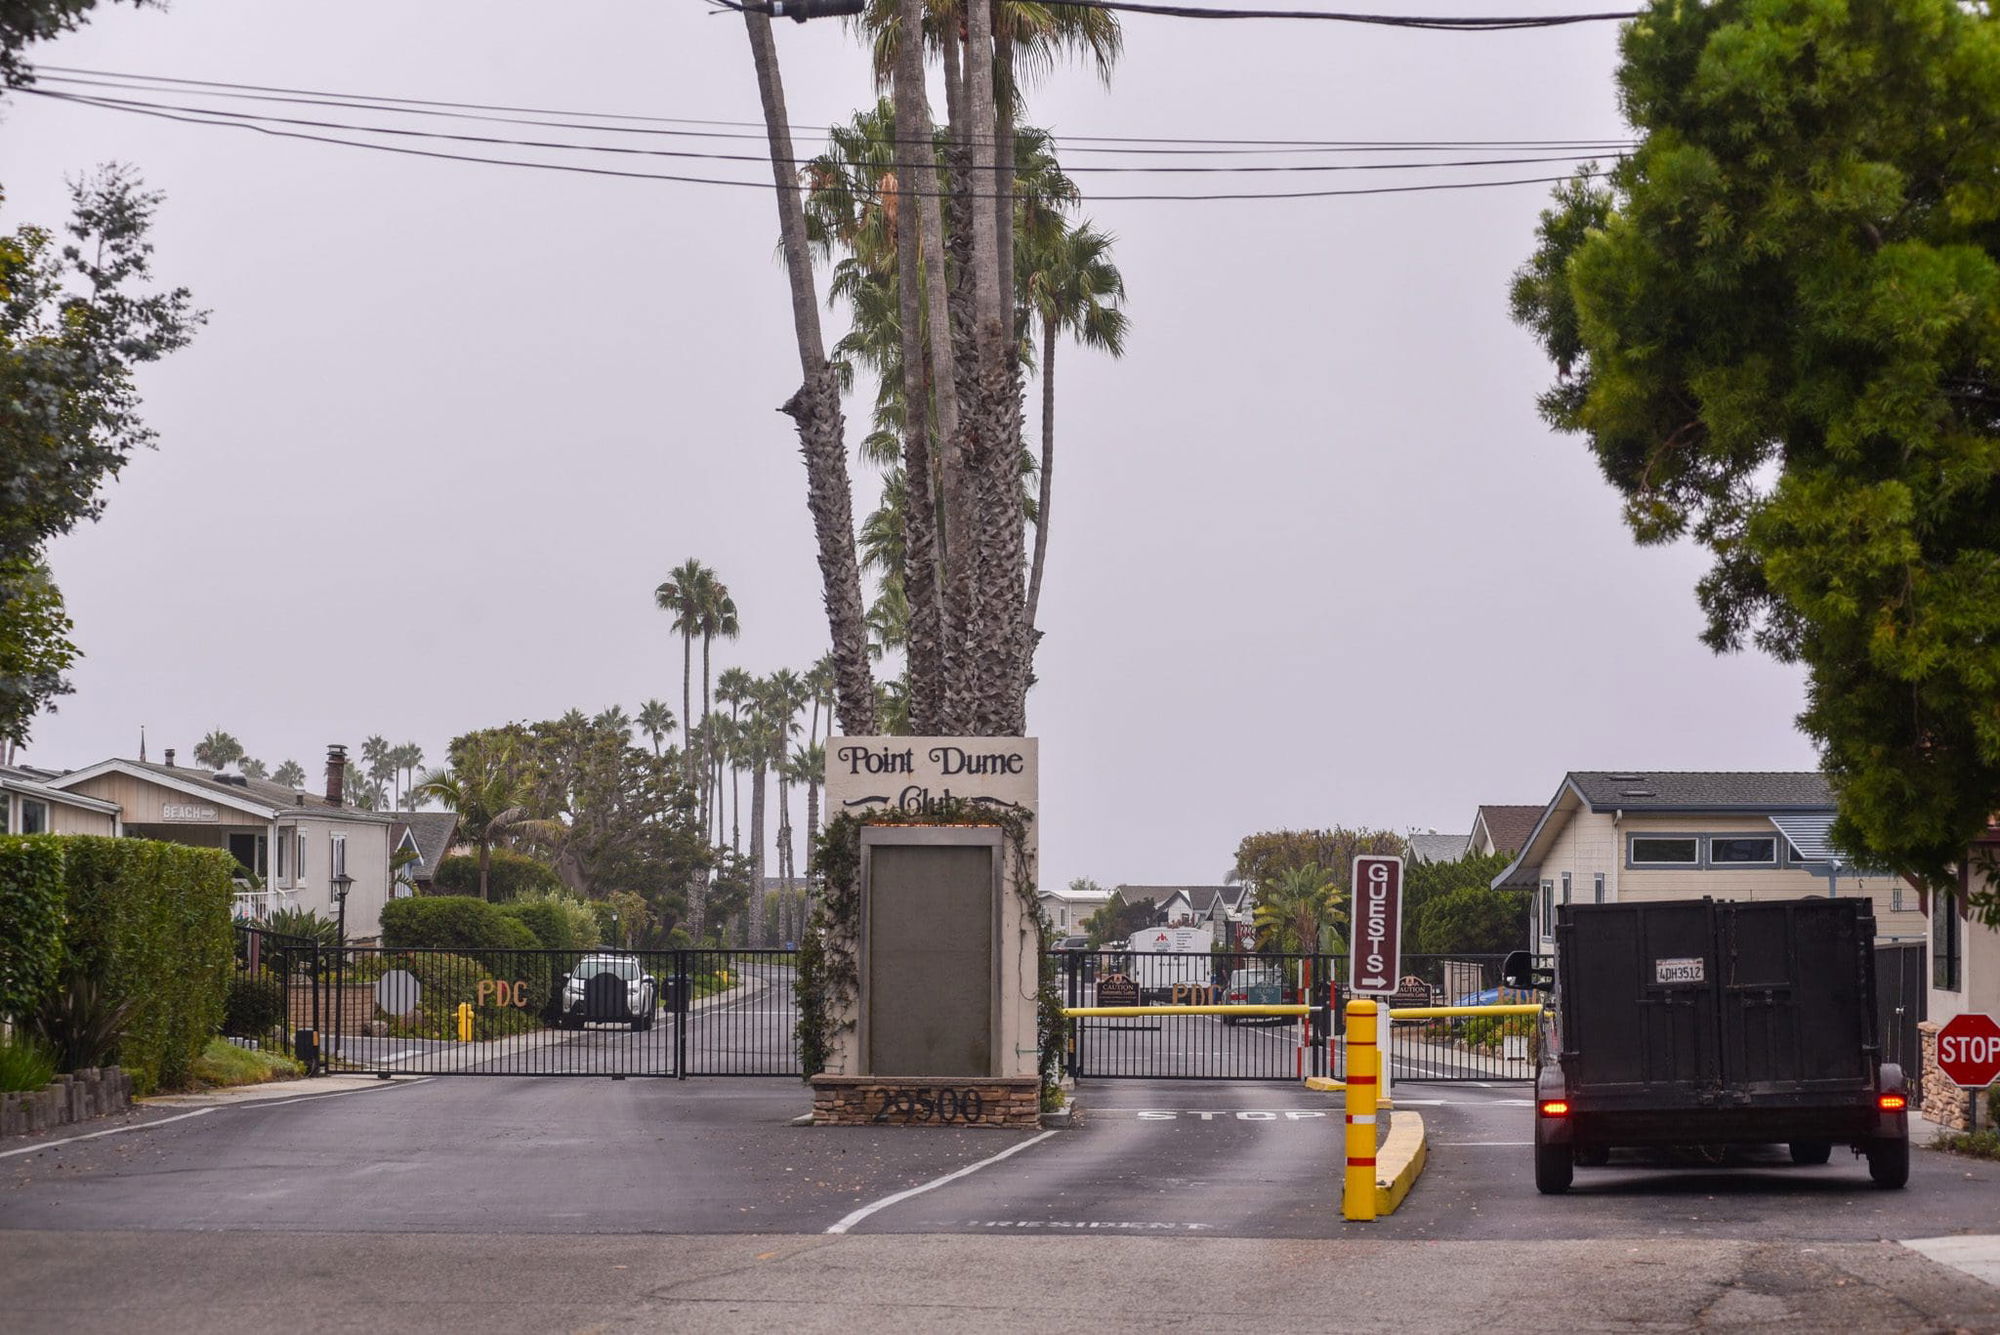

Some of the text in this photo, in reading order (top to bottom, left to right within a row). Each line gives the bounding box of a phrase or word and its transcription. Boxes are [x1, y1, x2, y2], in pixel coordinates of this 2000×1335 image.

[838, 747, 1024, 775] Point Dume
[163, 806, 200, 818] BEACH
[1366, 862, 1389, 973] GUESTS
[477, 979, 528, 1008] PDC
[1940, 1036, 2000, 1063] STOP
[873, 1087, 982, 1122] 29500
[1136, 1111, 1327, 1120] STOP
